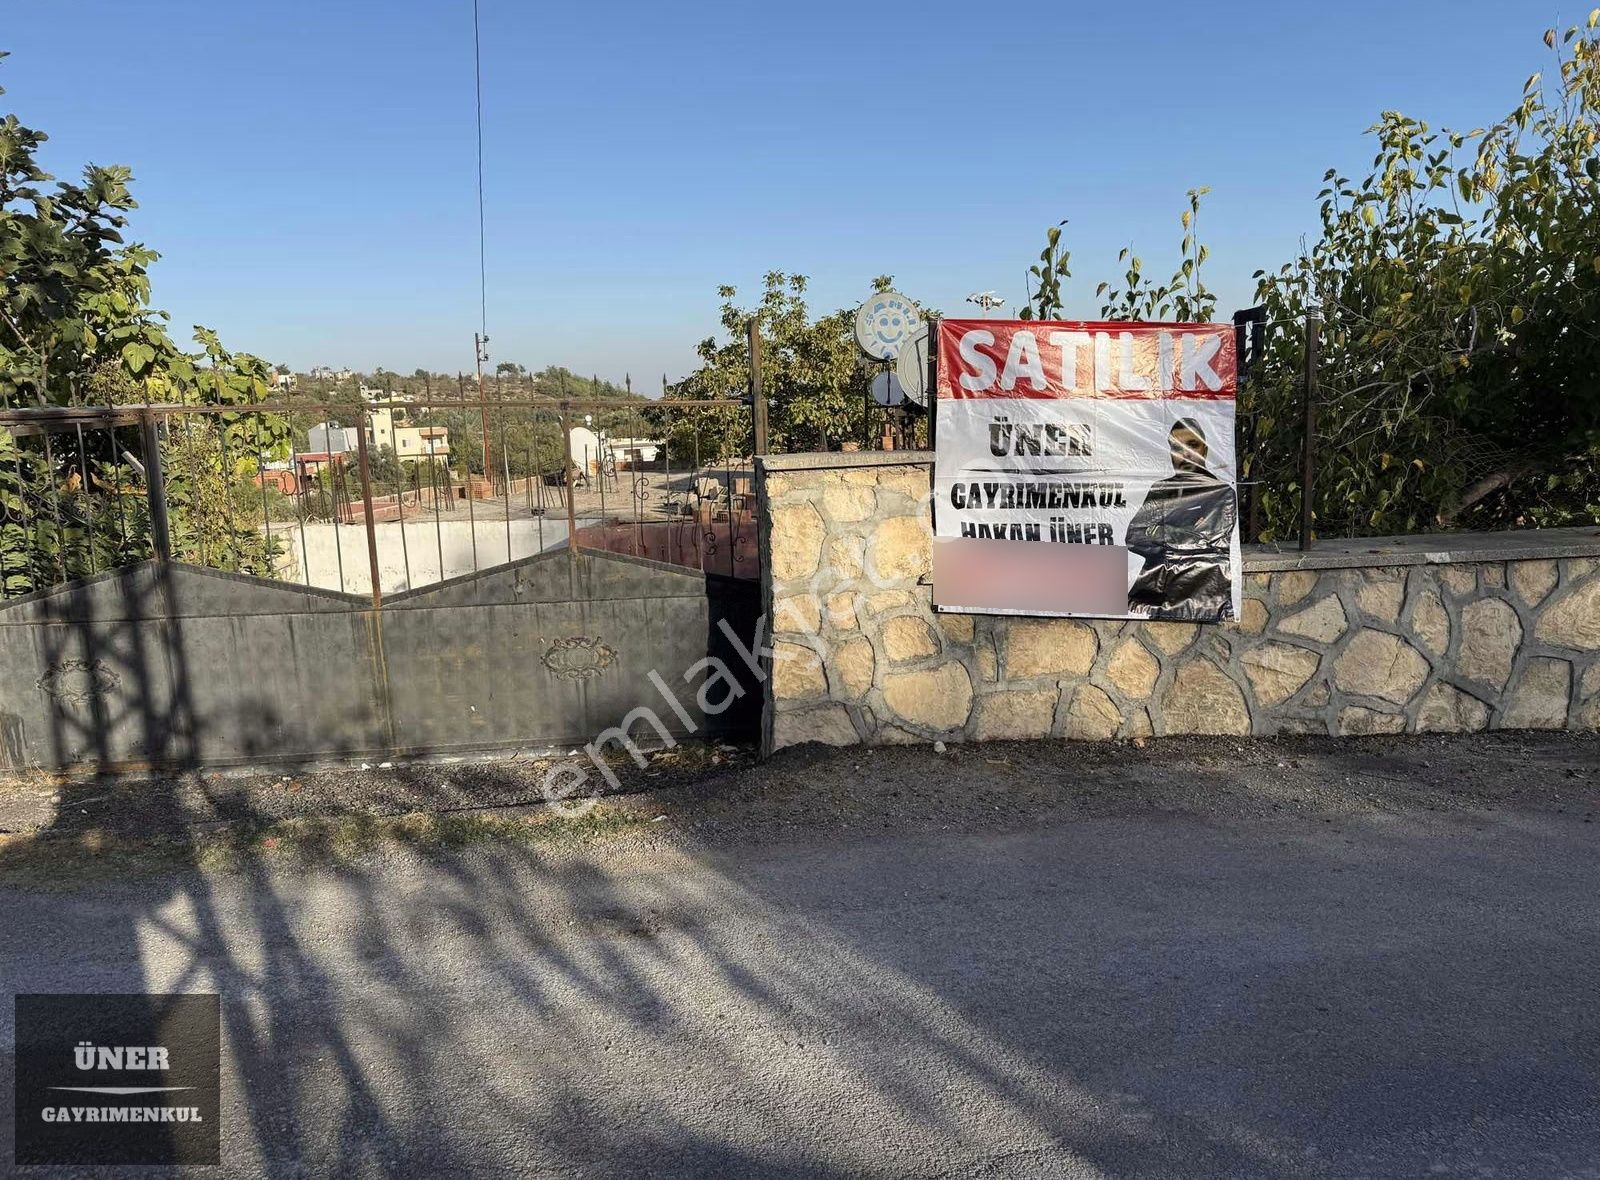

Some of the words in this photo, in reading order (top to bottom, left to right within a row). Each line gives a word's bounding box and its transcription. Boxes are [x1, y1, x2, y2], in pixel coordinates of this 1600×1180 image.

[958, 329, 1223, 392] SATILIK
[988, 415, 1092, 457] ÜNER
[950, 482, 1127, 509] GAYRIMENKUL
